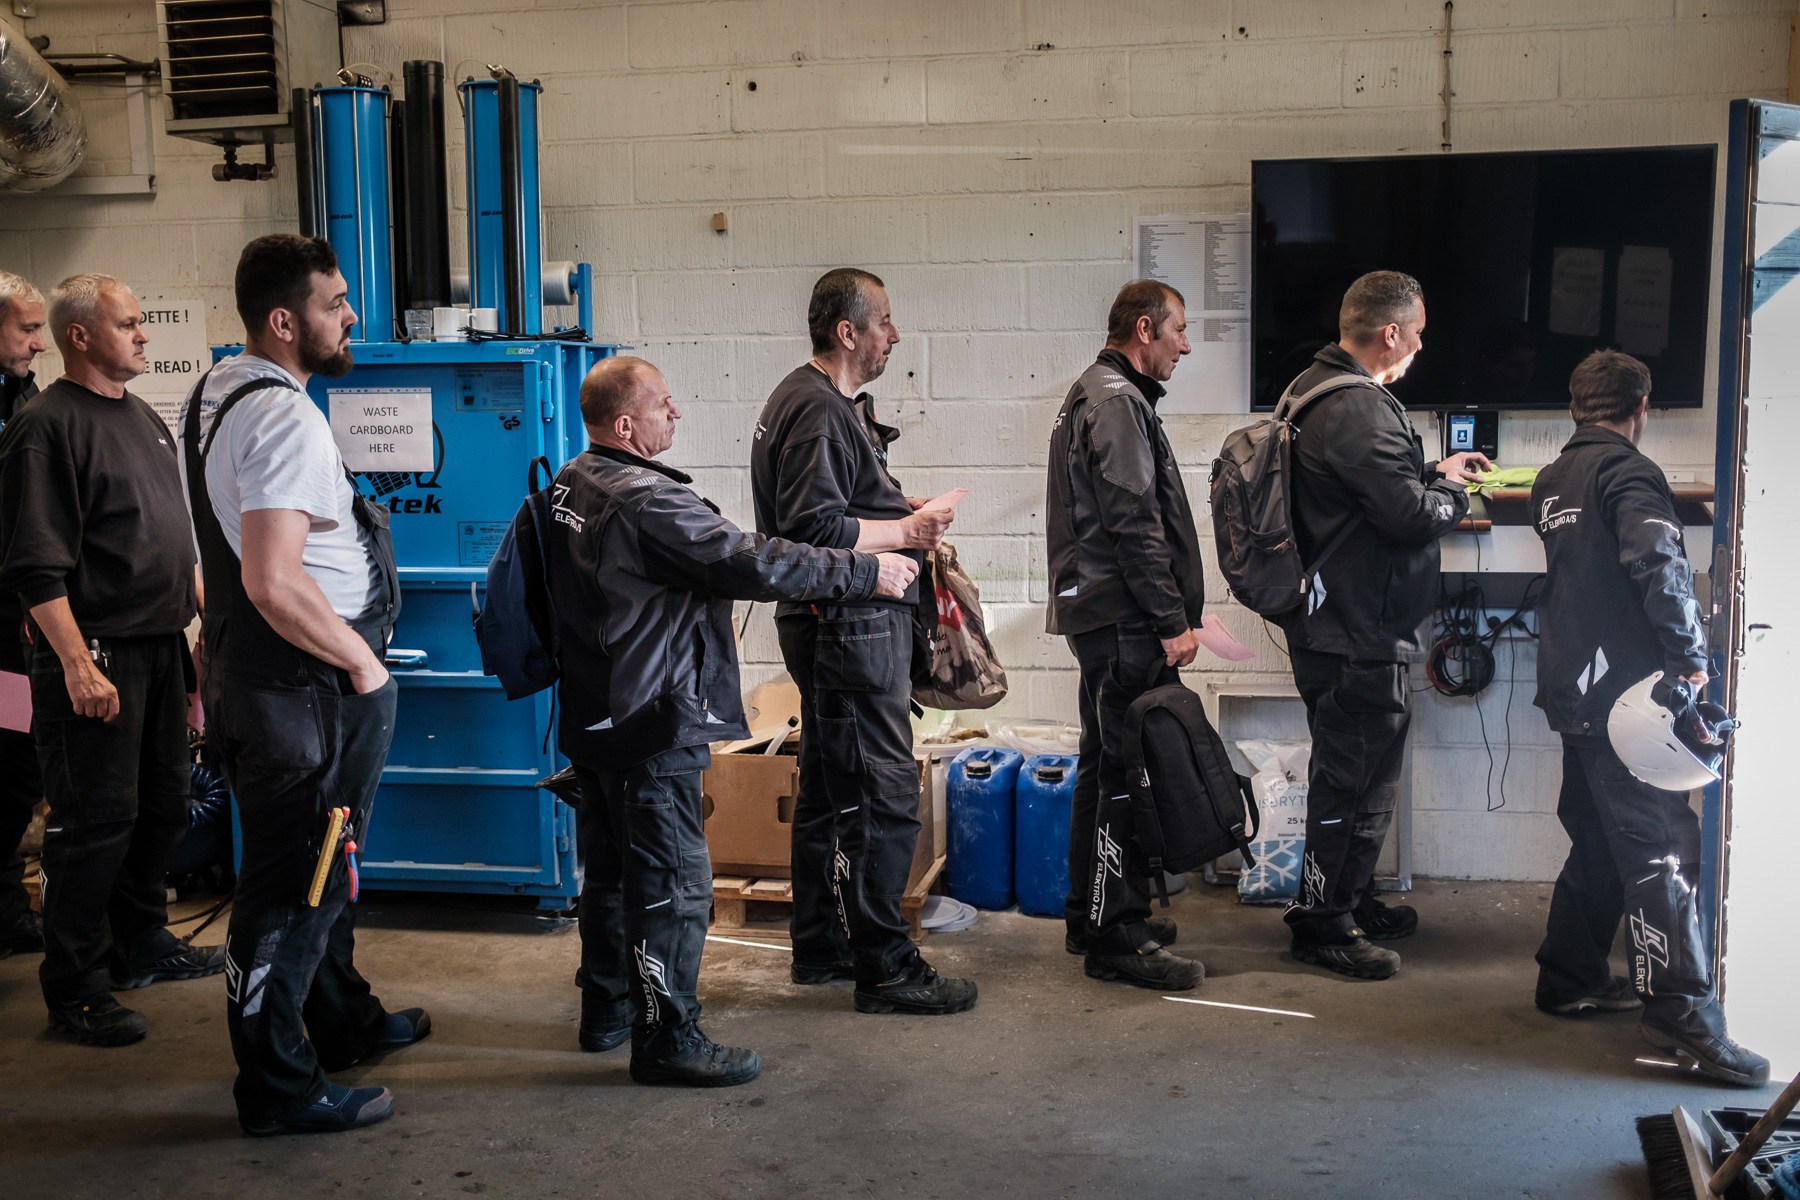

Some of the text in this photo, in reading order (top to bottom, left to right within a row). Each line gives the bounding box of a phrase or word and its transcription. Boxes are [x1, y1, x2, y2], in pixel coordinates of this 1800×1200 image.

[154, 360, 192, 374] READ
[363, 407, 398, 417] WASTE
[350, 425, 414, 435] CARDBOARD
[369, 443, 395, 453] HERE
[1287, 817, 1298, 825] 25
[1089, 862, 1104, 920] ELEKTRO A/S
[1635, 955, 1646, 992] ELEKTR
